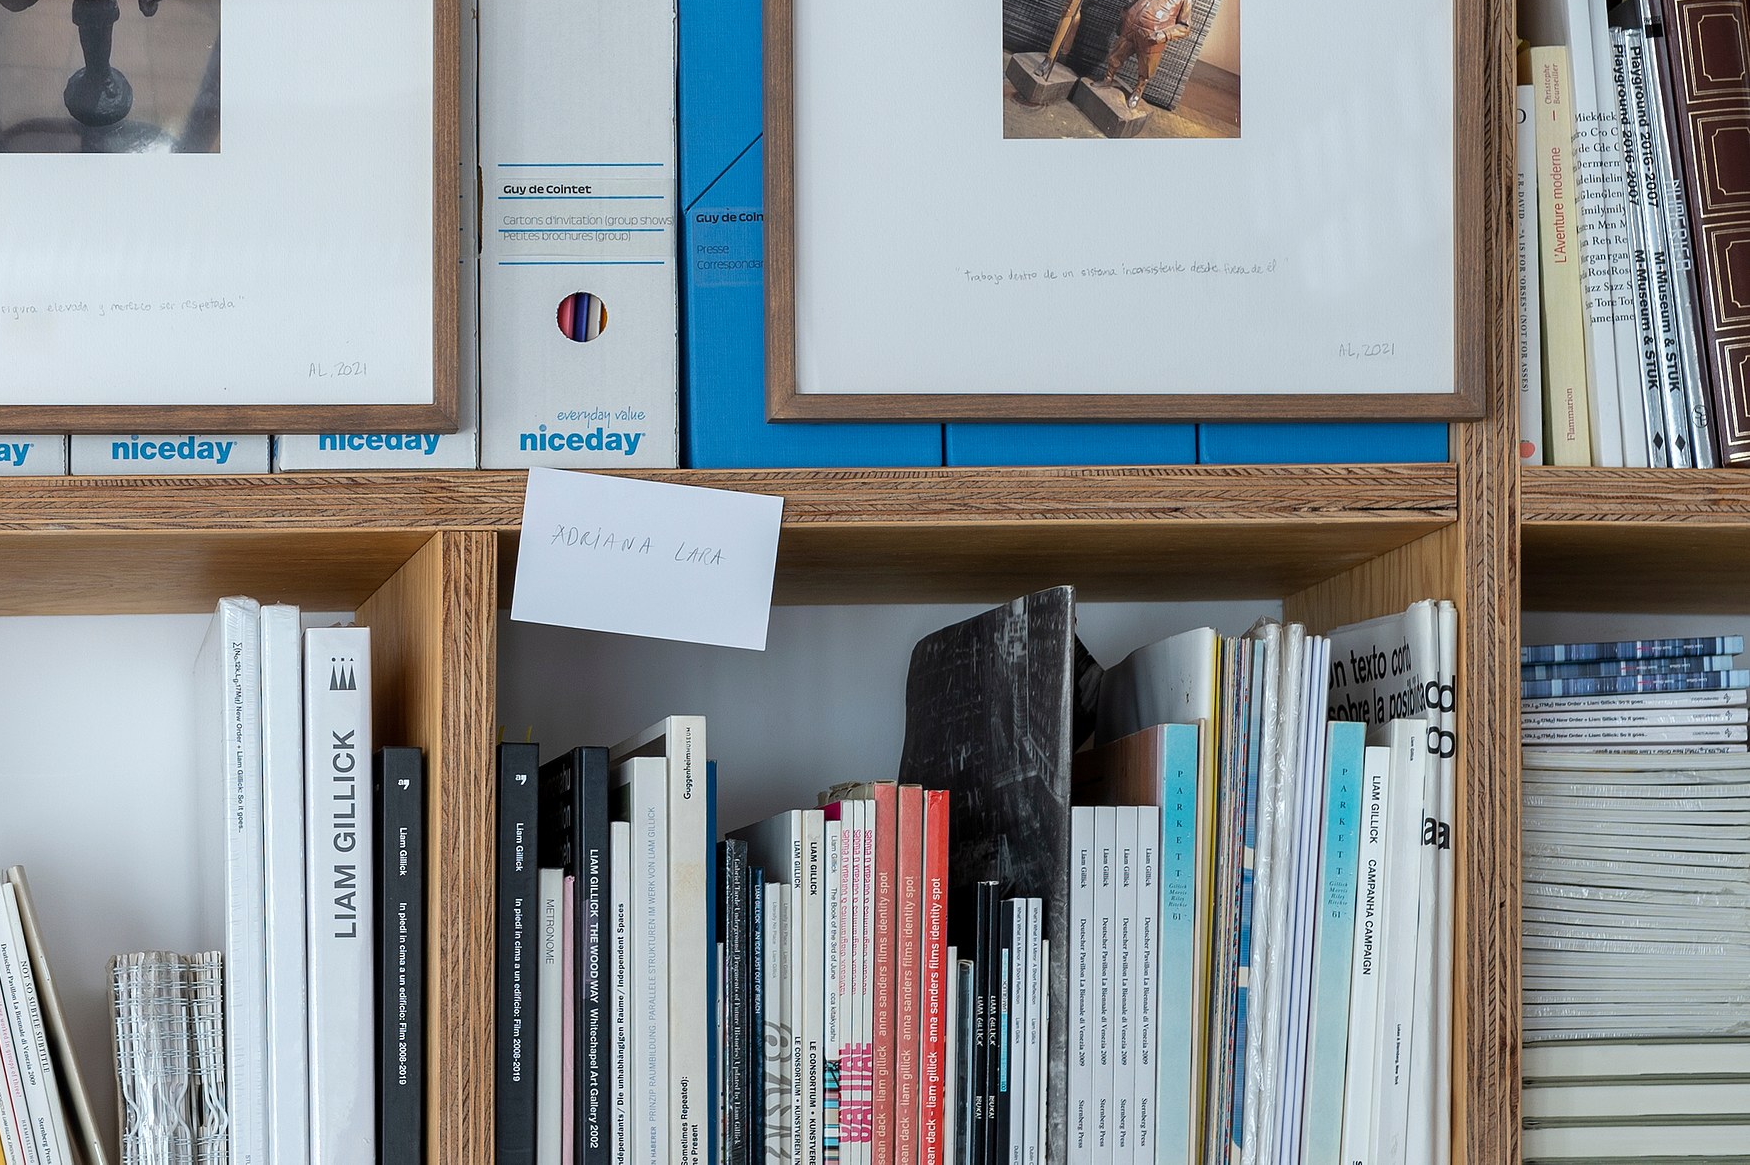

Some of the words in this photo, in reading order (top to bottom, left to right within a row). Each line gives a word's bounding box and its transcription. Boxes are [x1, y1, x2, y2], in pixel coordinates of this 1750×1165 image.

[503, 184, 525, 196] Guy
[528, 184, 544, 193] de
[545, 184, 592, 193] Cointet
[1552, 146, 1562, 199] moderne
[503, 215, 543, 226] Cartons
[557, 408, 612, 428] everyday
[616, 408, 646, 421] value
[520, 424, 642, 455] niceday
[551, 524, 655, 554] ADRIANA
[675, 542, 727, 565] LARA
[333, 729, 356, 852] GILLICK
[1371, 775, 1381, 801] LIAM
[1175, 770, 1183, 878] PARKETT
[1370, 802, 1380, 844] GILLICK
[589, 849, 598, 875] LIAM
[335, 865, 356, 938] LIAM
[589, 877, 598, 917] GILLICK
[932, 878, 941, 902] spot
[1365, 858, 1376, 919] CAMPANHA
[545, 899, 555, 965] METRONOME
[590, 923, 598, 943] THE
[931, 904, 940, 942] identity
[590, 944, 598, 978] WOOD
[931, 946, 939, 970] films
[1362, 920, 1373, 975] CAMPAIGN
[590, 979, 598, 1003] WAY
[930, 973, 939, 1013] sanders
[589, 1008, 598, 1069] Whitechapel
[929, 1017, 938, 1043] anna
[590, 1070, 598, 1085] Art
[588, 1088, 598, 1124] Gallery
[590, 1125, 598, 1149] 2002
